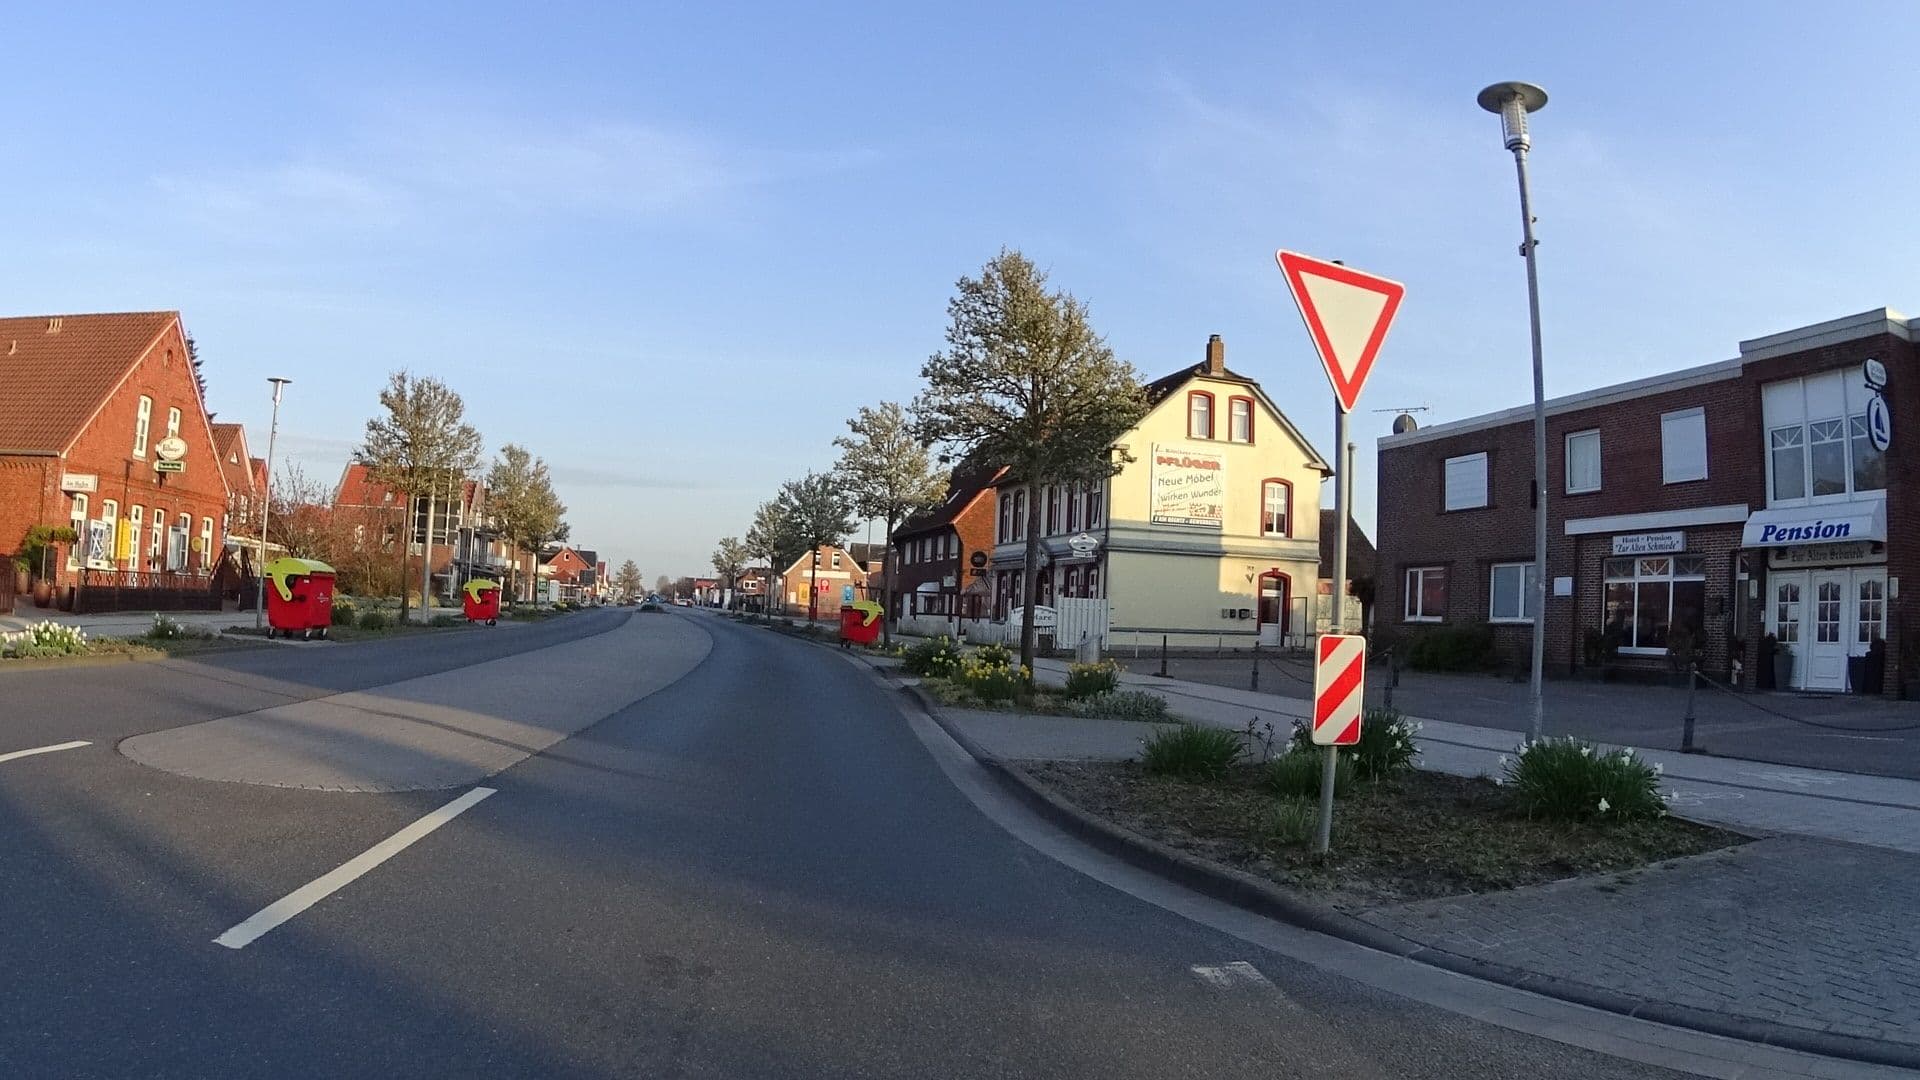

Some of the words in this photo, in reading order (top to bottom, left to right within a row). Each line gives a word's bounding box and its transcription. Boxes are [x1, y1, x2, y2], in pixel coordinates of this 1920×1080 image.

[1158, 477, 1182, 487] Neue
[1186, 472, 1214, 484] Möbel
[1646, 534, 1672, 542] Pension
[1760, 520, 1851, 543] Pension
